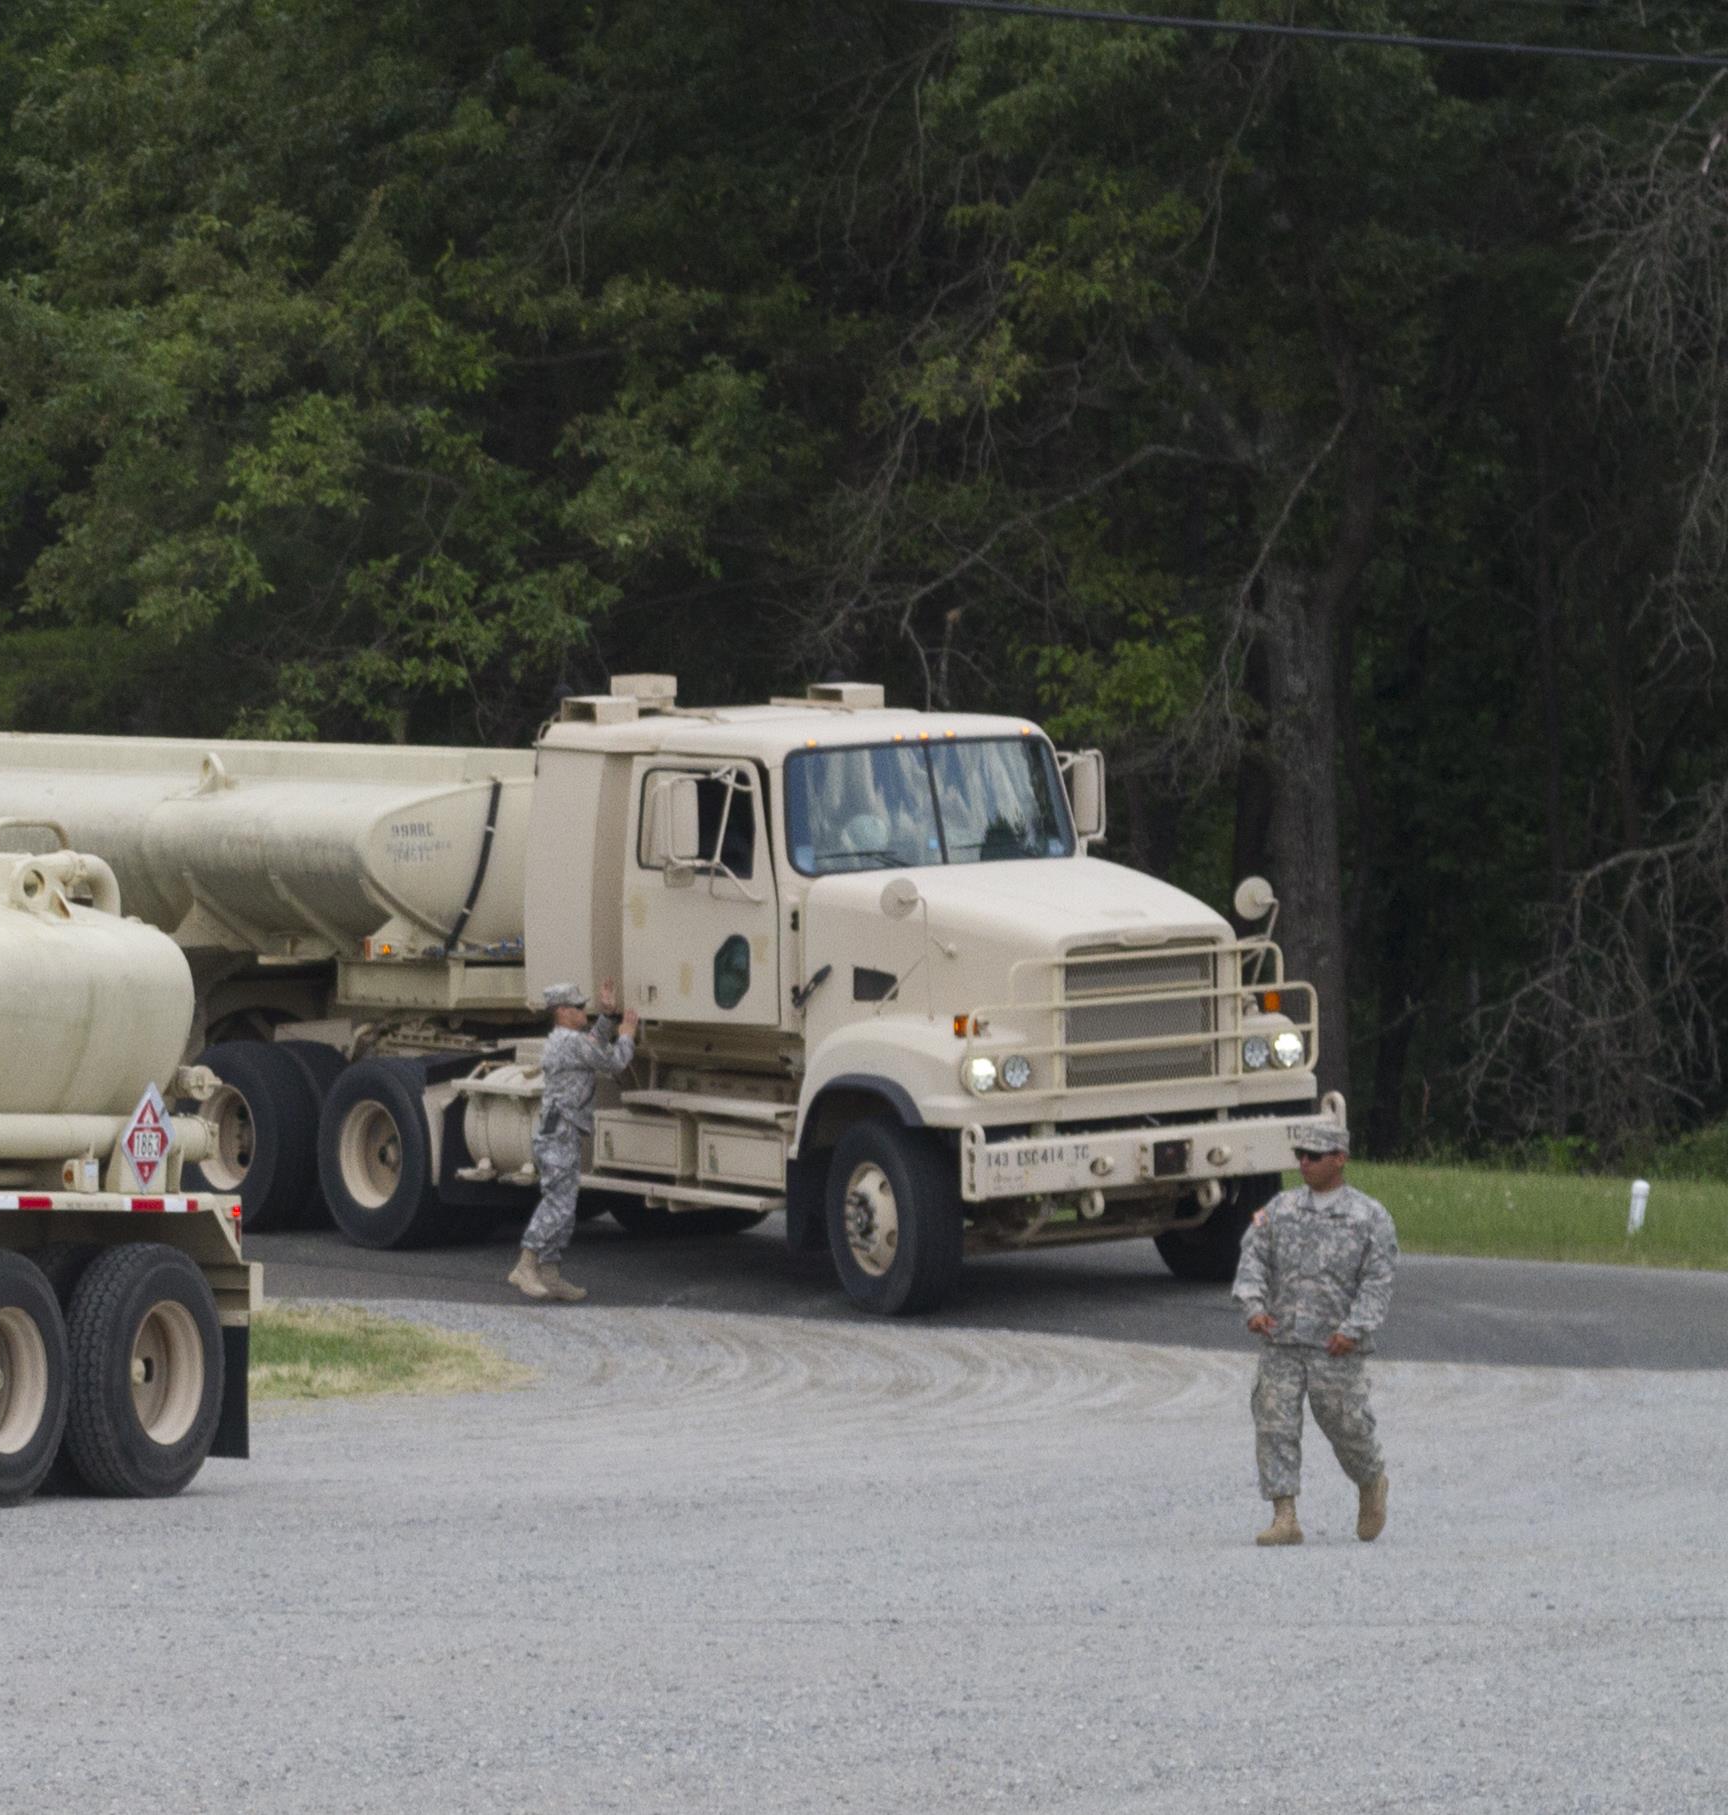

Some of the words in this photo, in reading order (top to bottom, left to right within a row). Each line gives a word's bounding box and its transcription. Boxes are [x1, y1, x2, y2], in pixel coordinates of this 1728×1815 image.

[136, 1133, 161, 1156] 1863
[987, 1152, 1008, 1168] 143
[1074, 1144, 1089, 1160] TC
